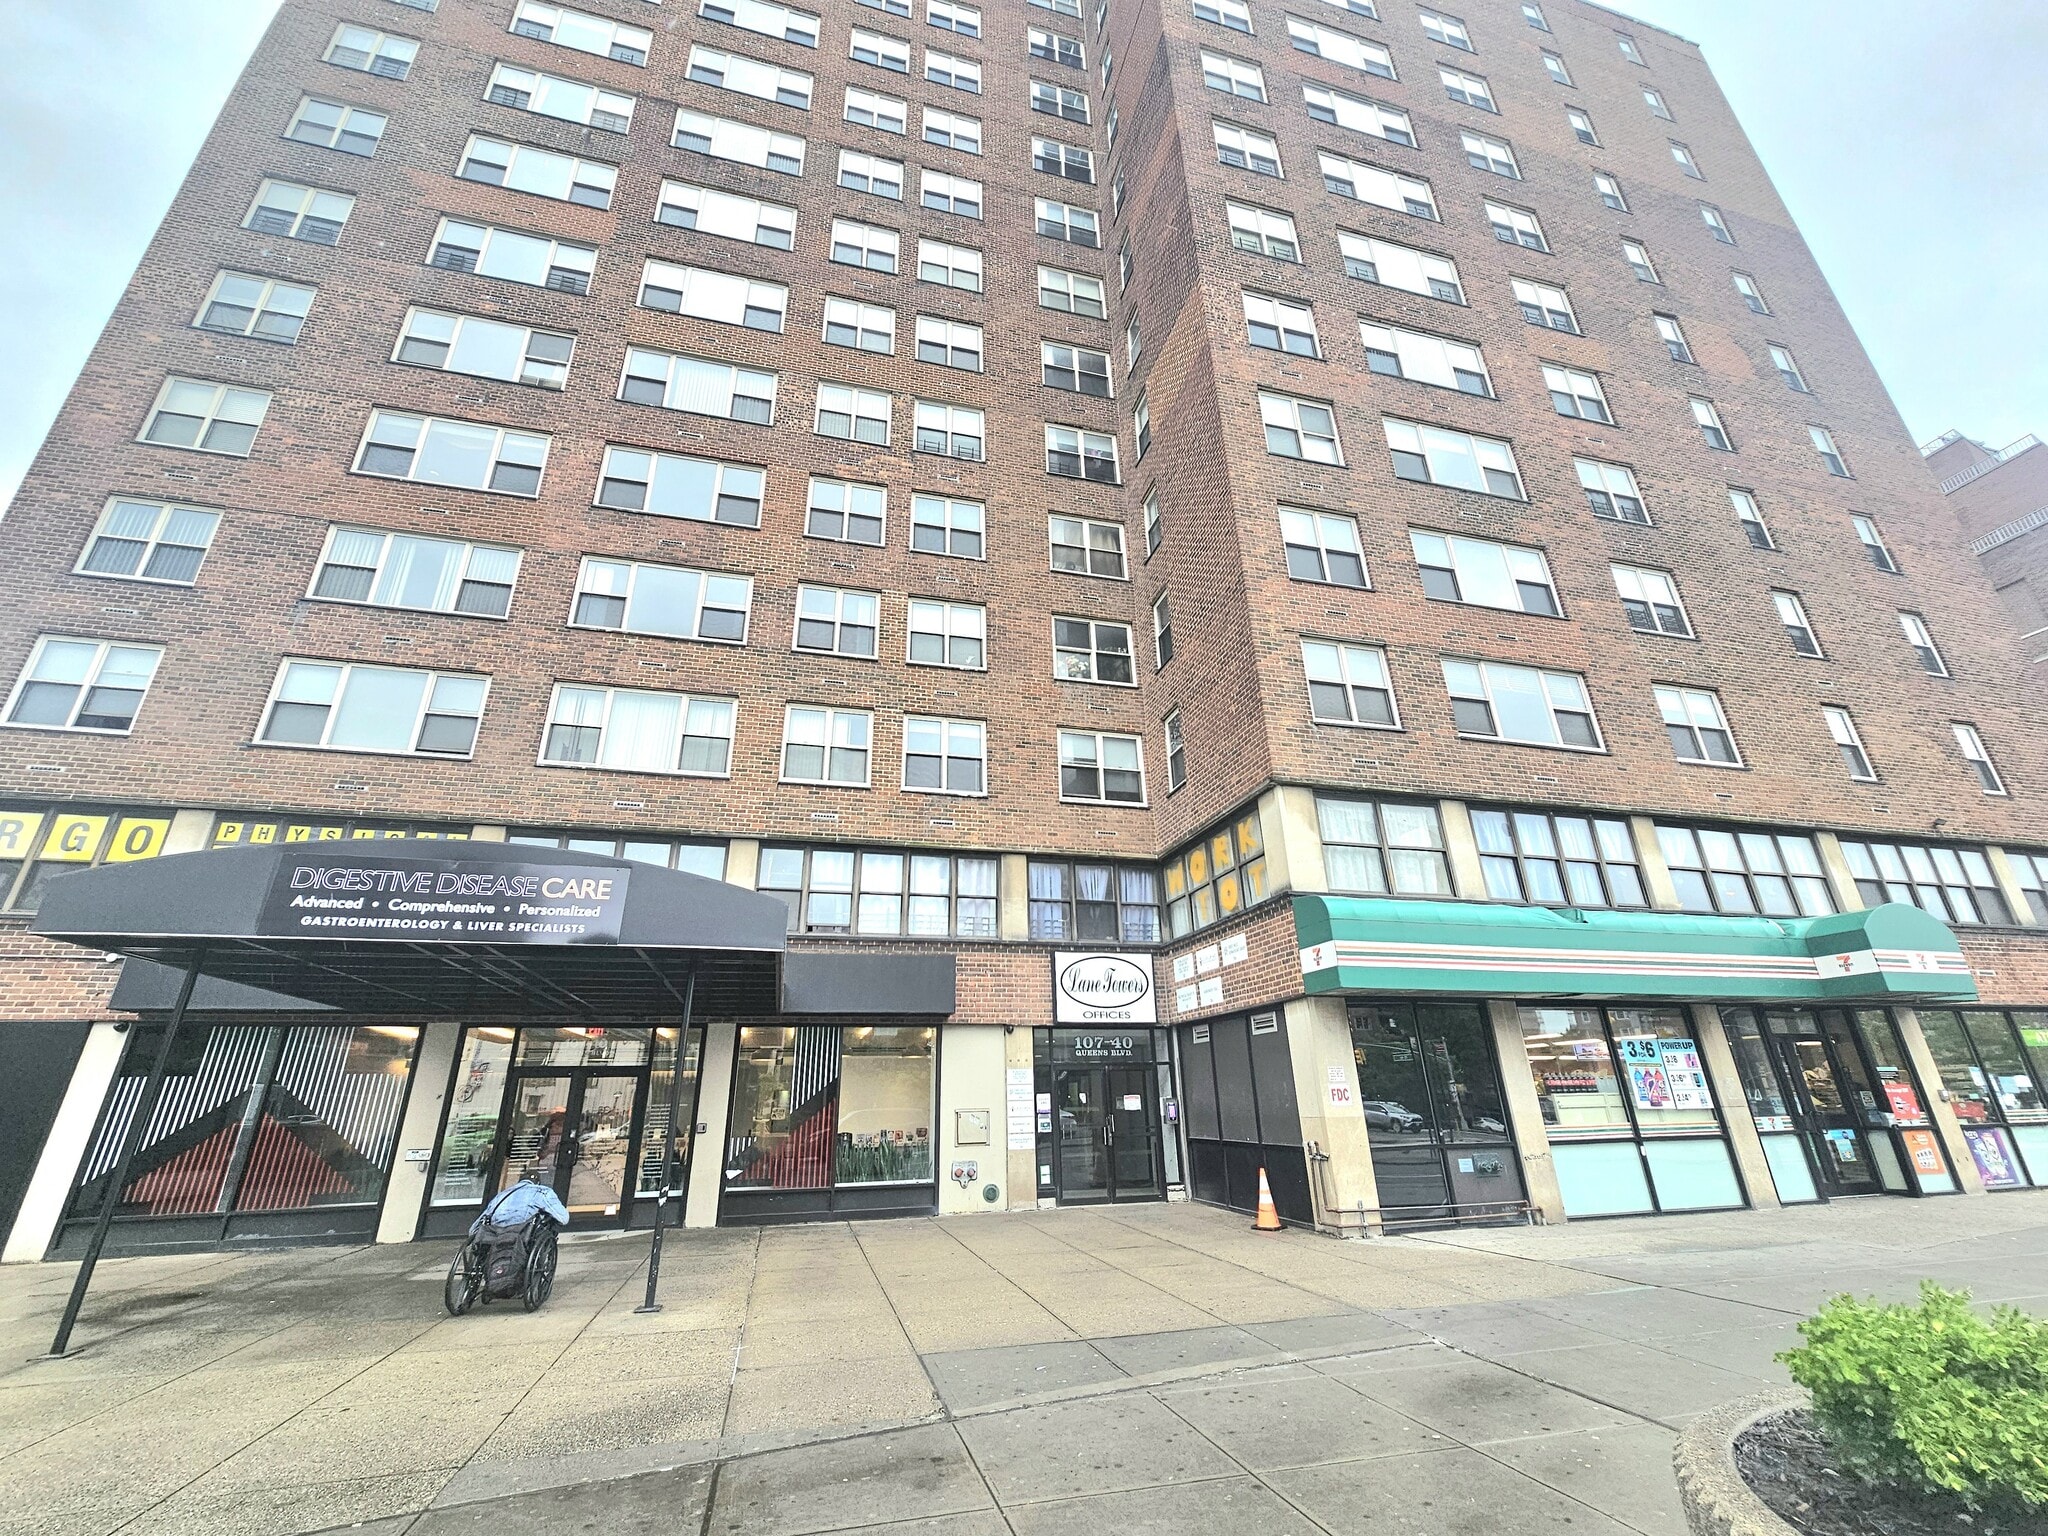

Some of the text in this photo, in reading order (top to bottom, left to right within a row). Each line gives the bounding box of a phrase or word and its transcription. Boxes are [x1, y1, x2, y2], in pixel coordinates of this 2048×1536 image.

[290, 867, 613, 900] DIGESTIVE DISEASE CARE
[290, 895, 600, 918] Advanced Comprehensive Personalized
[300, 916, 585, 934] GASTROENTEROLOGY & LIVER SPECIALISTS
[1067, 967, 1143, 993] Lane Towers
[1082, 1010, 1131, 1019] OFFICES
[1074, 1036, 1133, 1049] 107-40
[1627, 1041, 1638, 1058] 3
[1075, 1049, 1109, 1057] QUEENS
[1331, 1088, 1350, 1101] FDC
